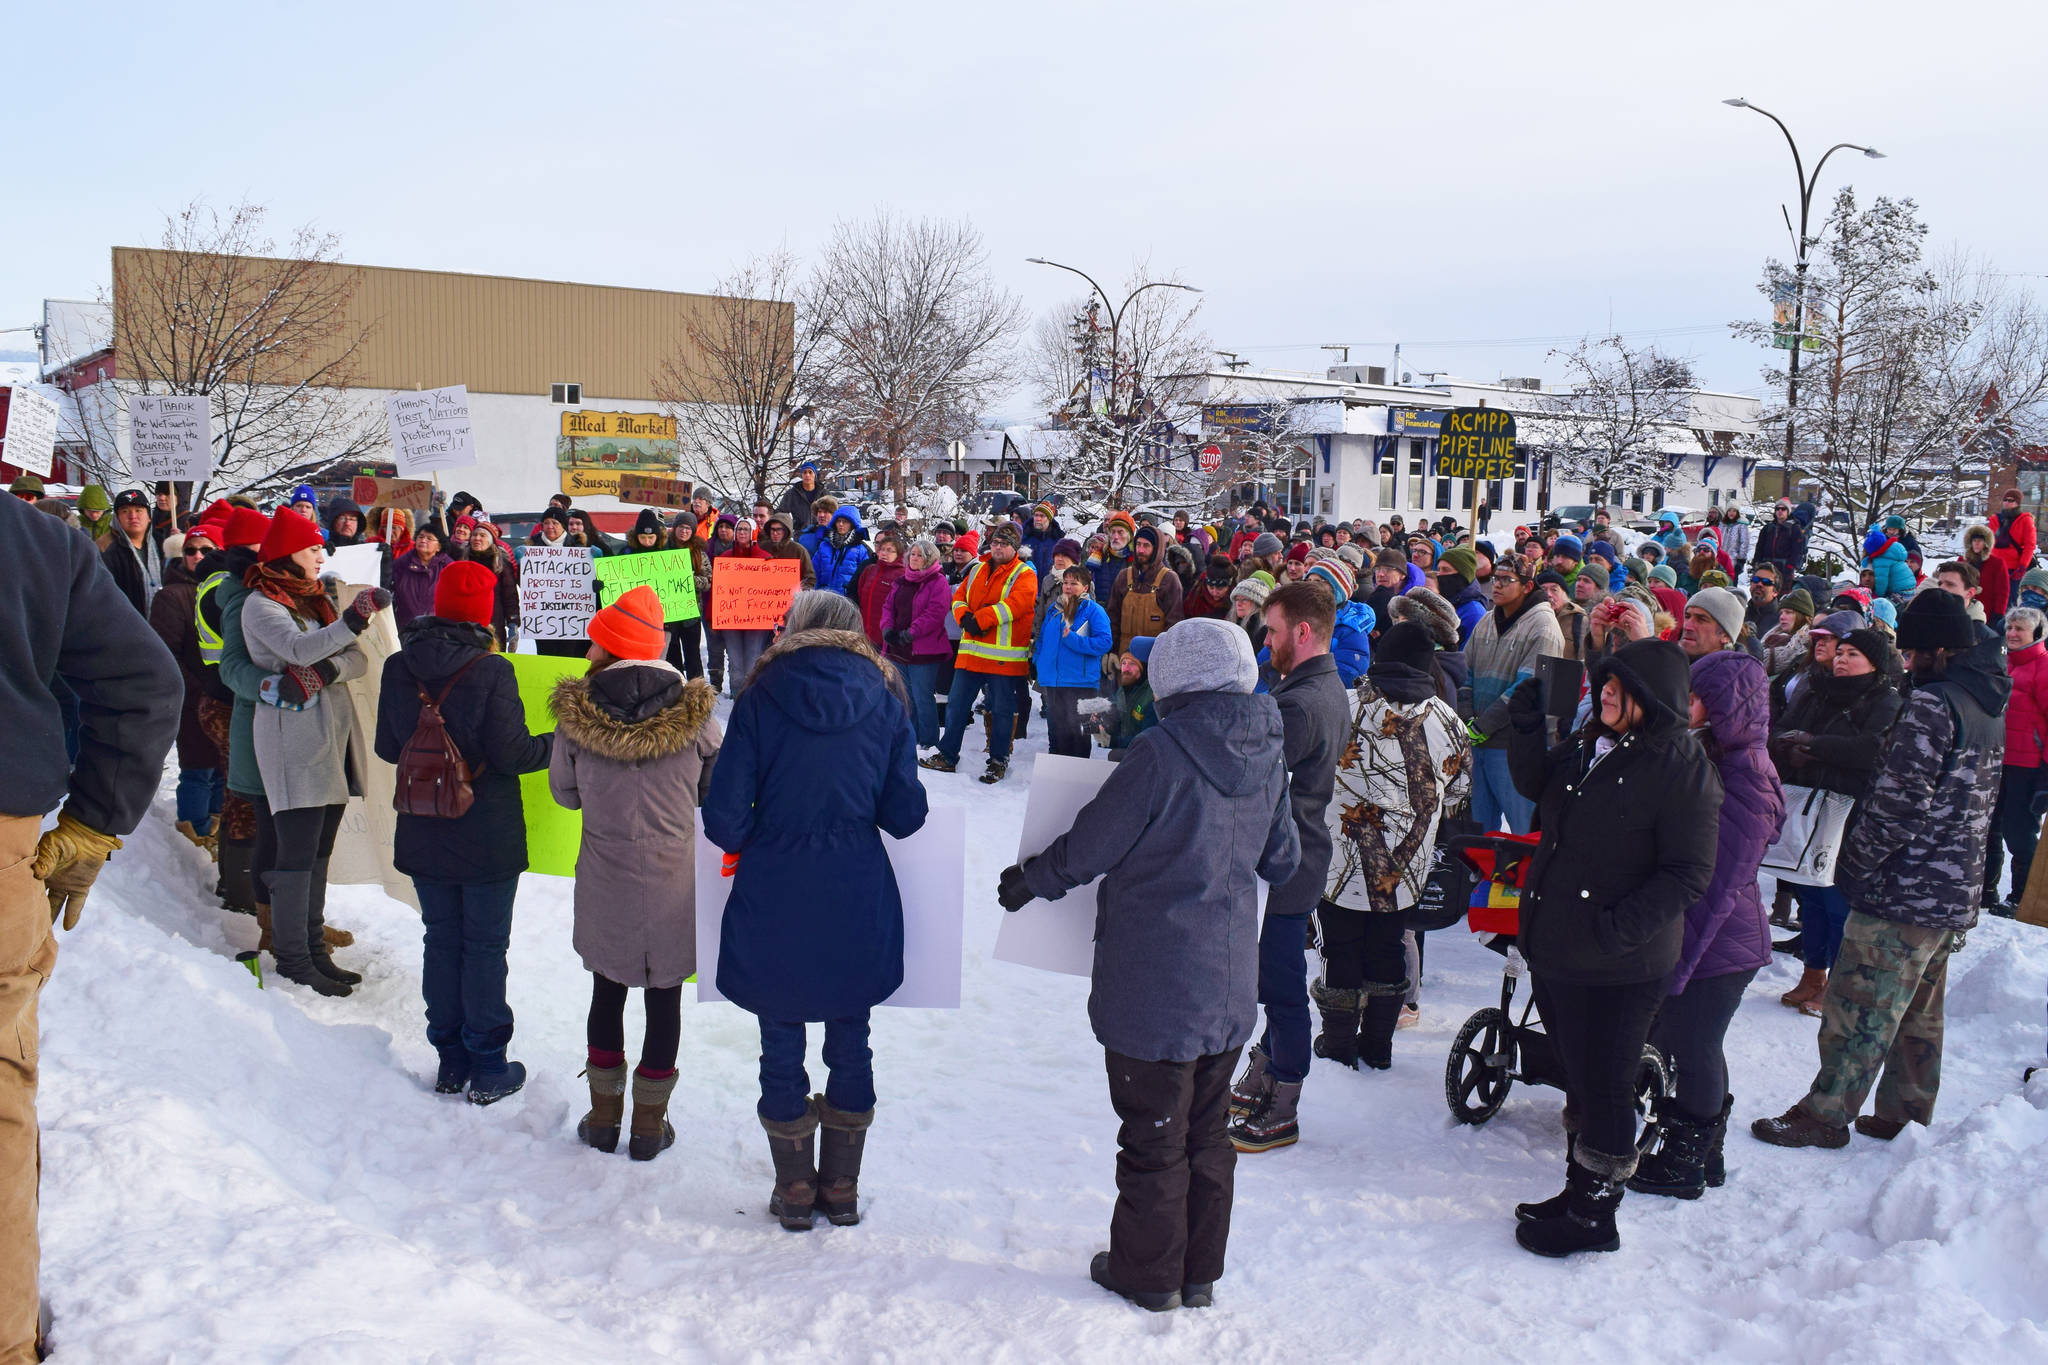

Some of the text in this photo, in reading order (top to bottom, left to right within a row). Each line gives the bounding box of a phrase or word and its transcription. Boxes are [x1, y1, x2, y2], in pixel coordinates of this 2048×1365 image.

[139, 398, 195, 412] We THANK
[393, 390, 456, 410] THANK You
[395, 411, 422, 424] FIRST
[1405, 411, 1417, 419] RBC
[132, 416, 147, 428] the
[420, 420, 432, 430] for
[569, 414, 670, 435] Meat Market
[1450, 412, 1509, 433] RCMPP
[136, 429, 200, 445] for having the
[401, 426, 471, 444] Protecting our
[133, 440, 192, 452] COURAGE to
[401, 443, 447, 457] FUTURE
[1440, 434, 1515, 458] PIPELINE
[136, 456, 192, 468] Protect our
[1202, 453, 1220, 465] STOP
[154, 465, 185, 477] Earth
[1439, 456, 1515, 480] PUPPETS
[524, 548, 587, 558] WHEN YOU ARE
[522, 559, 592, 575] ATTACKED
[596, 558, 629, 580] GIVE
[649, 555, 658, 574] A
[660, 554, 686, 573] WAY
[527, 578, 582, 588] PROTEST IS
[523, 590, 592, 601] NOT ENOUGH
[601, 581, 618, 606] OF
[655, 580, 666, 599] to
[668, 575, 693, 596] MAKE
[729, 586, 744, 596] NOT
[523, 602, 595, 613] THE INSTINCT IS TO
[720, 599, 739, 612] BUT
[522, 615, 590, 638] RESIST
